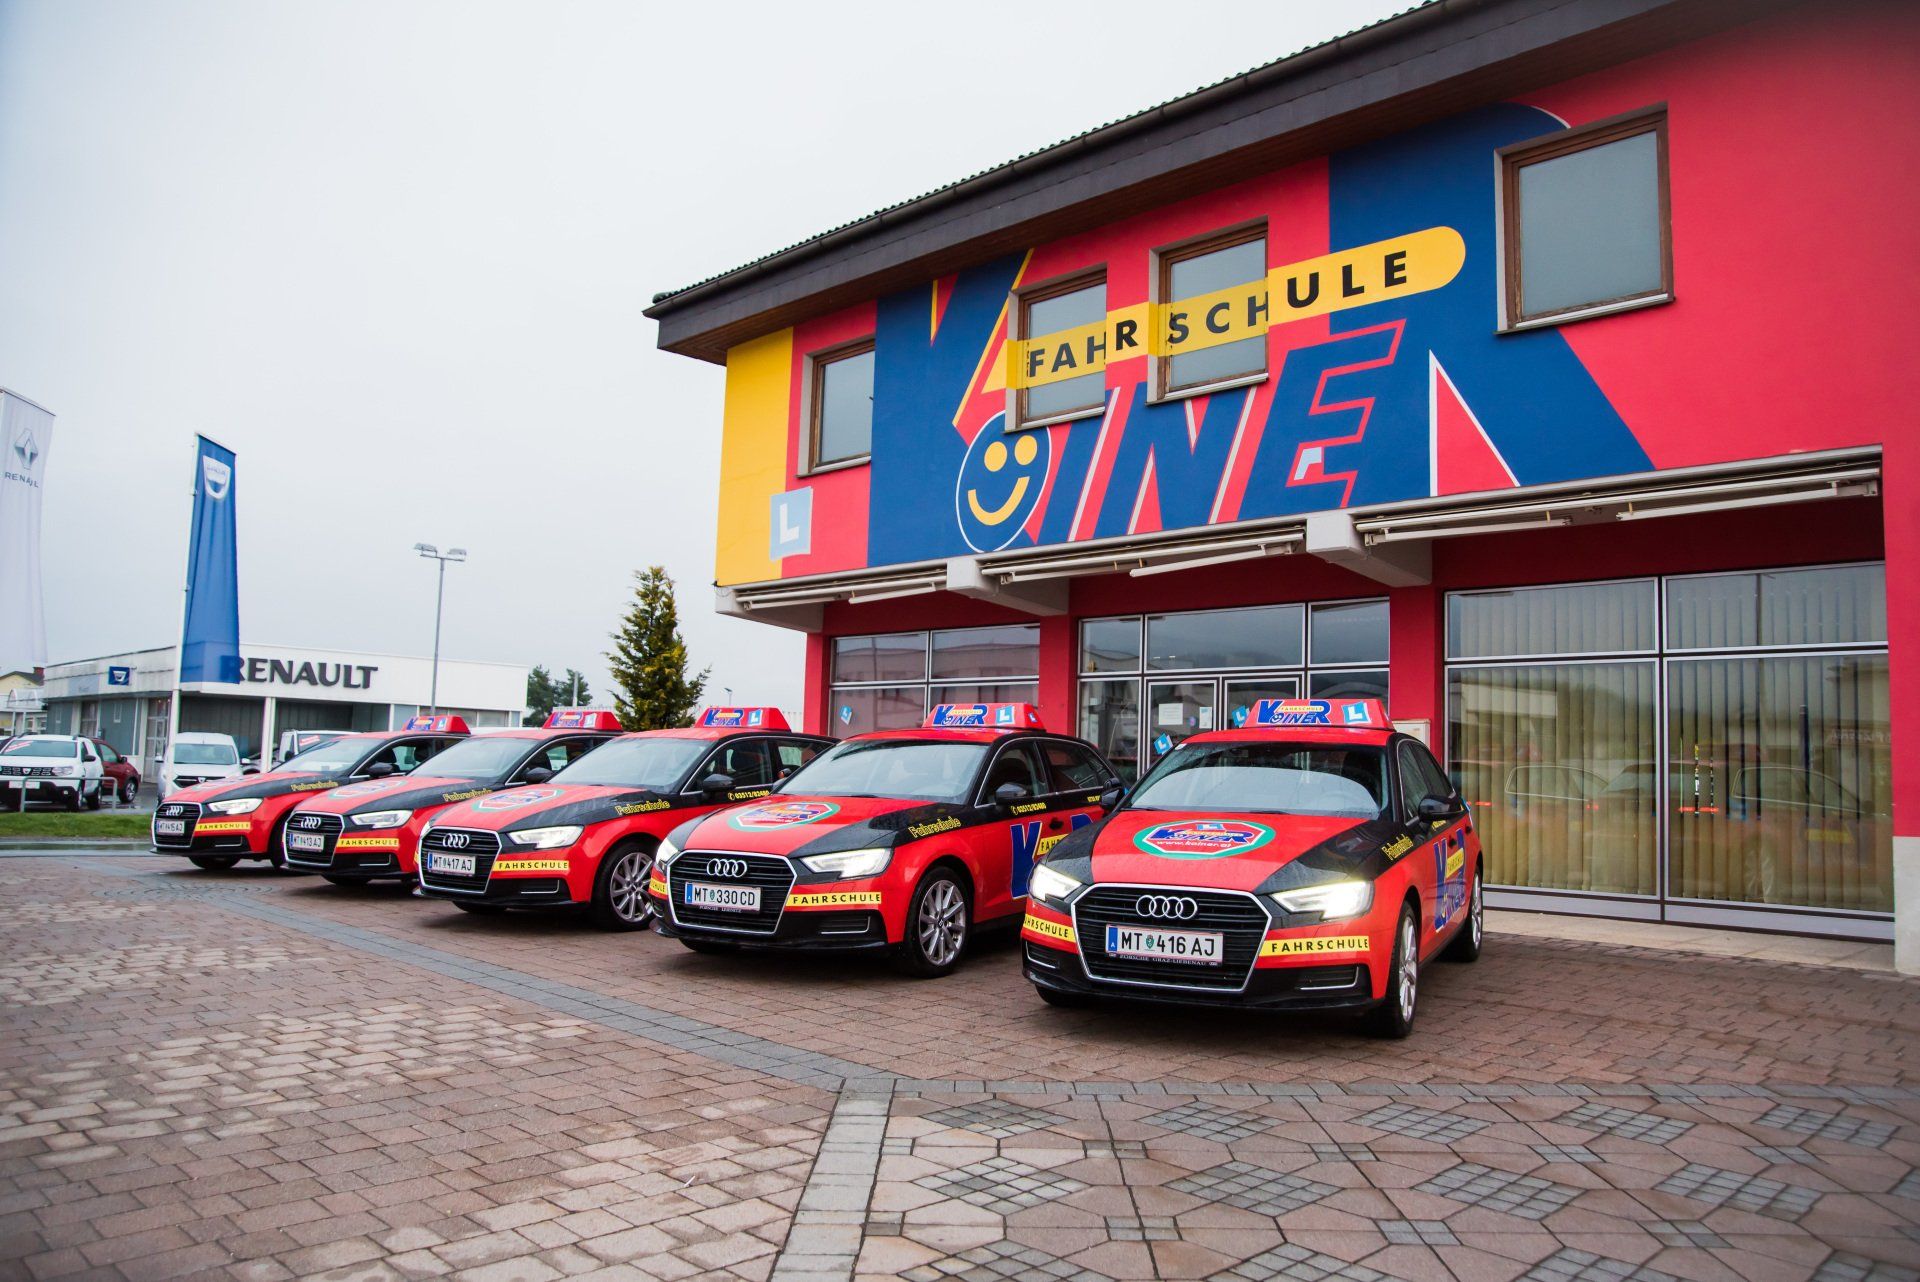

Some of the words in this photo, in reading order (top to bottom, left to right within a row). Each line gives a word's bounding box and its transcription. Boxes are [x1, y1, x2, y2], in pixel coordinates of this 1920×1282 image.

[499, 861, 568, 869] FAHRSCHULE
[694, 887, 708, 902] MT
[716, 889, 738, 904] 330
[740, 891, 755, 905] CD
[793, 894, 881, 904] FAHRSCHULE
[1121, 932, 1143, 950] MT
[1156, 936, 1186, 955] 416
[1191, 938, 1215, 957] AJ
[1272, 938, 1369, 952] FAHRSCHULE
